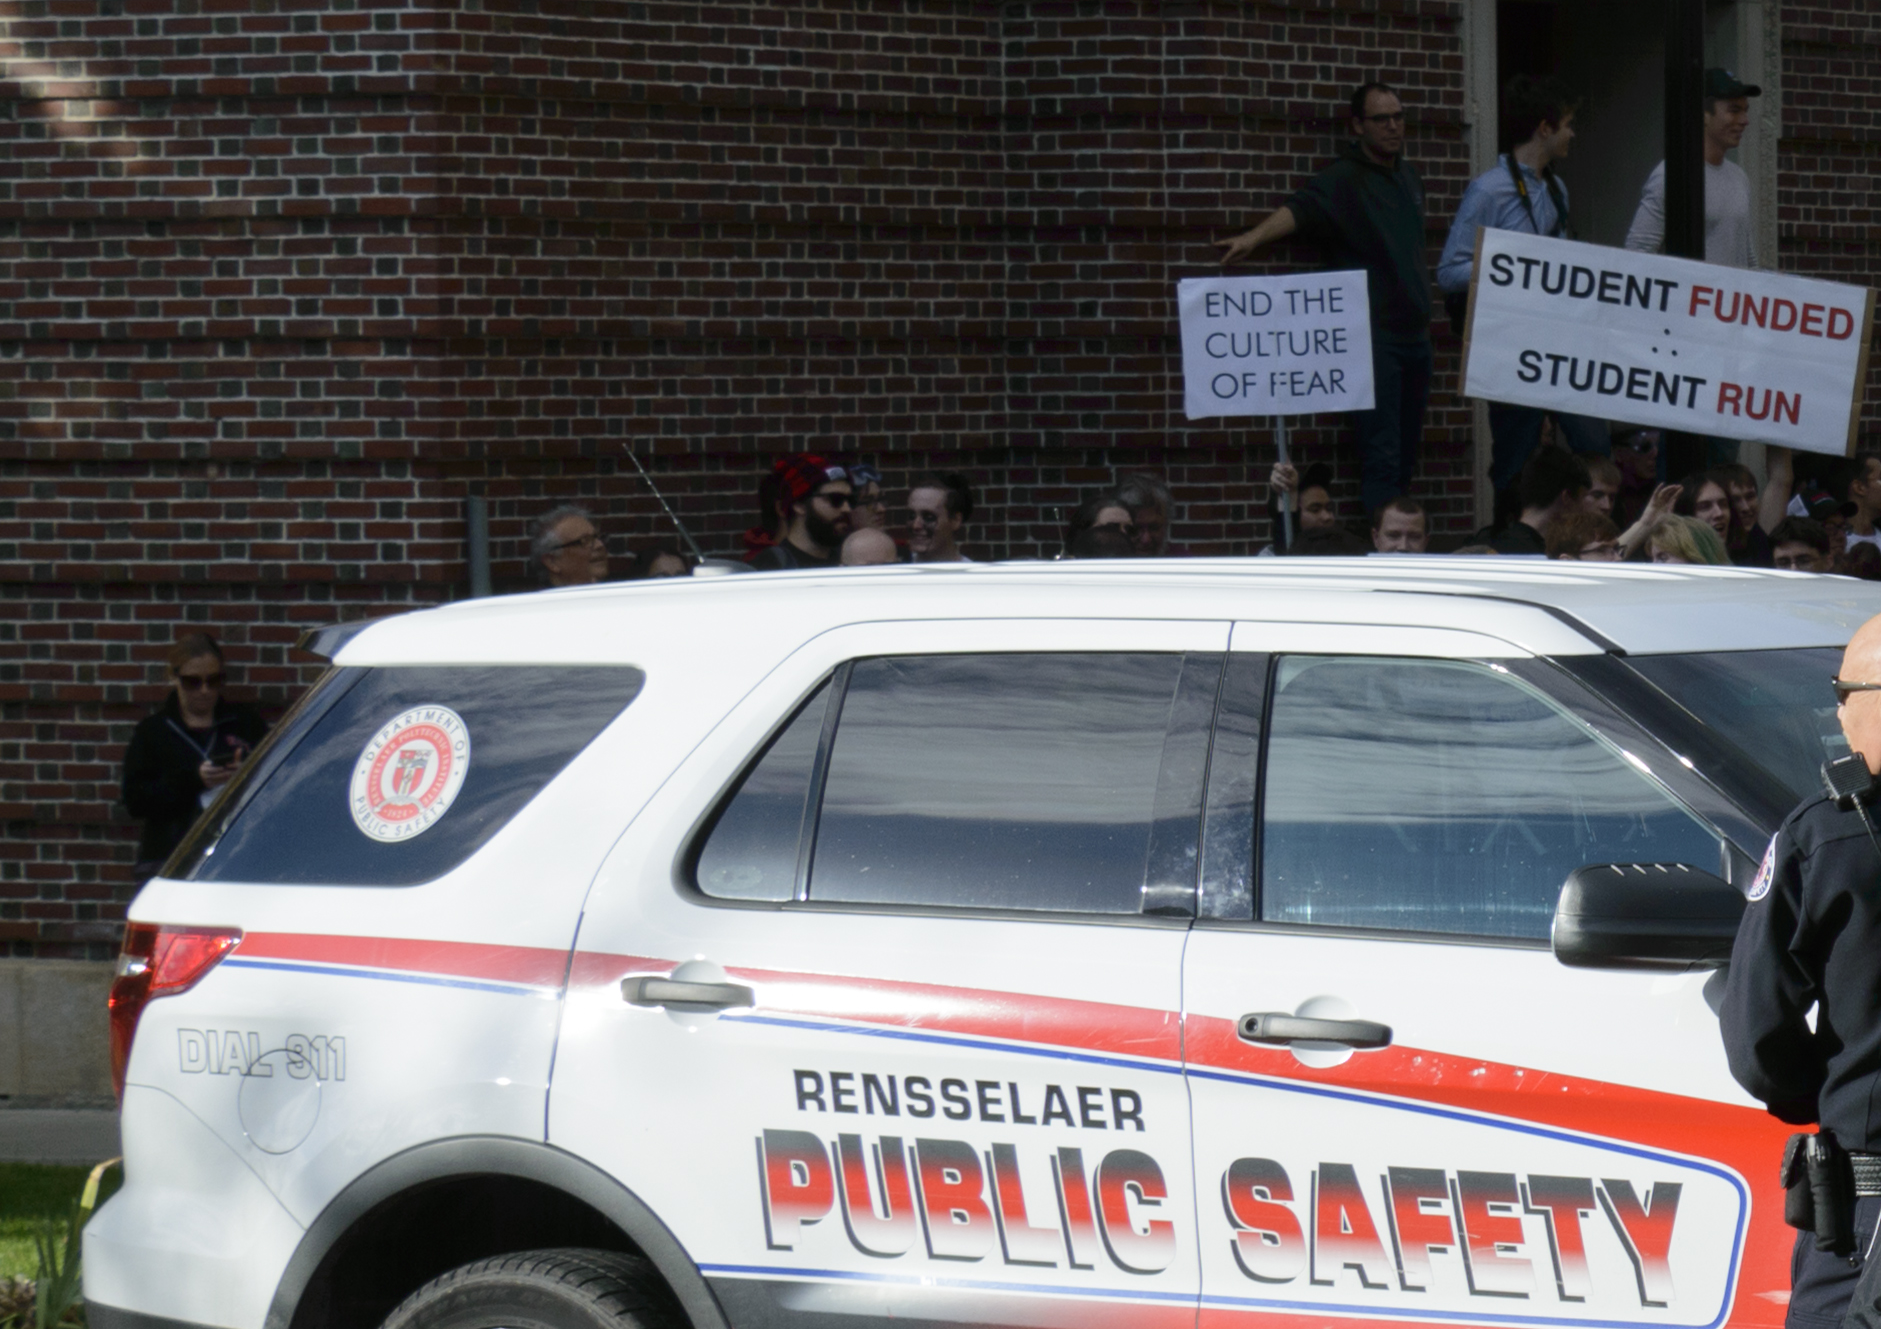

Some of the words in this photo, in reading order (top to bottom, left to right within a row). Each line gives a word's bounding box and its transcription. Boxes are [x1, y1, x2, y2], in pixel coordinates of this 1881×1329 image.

[1205, 291, 1272, 318] END
[1283, 287, 1344, 315] THE
[1488, 253, 1679, 312] STUDENT
[1689, 285, 1855, 341] FUNDED
[1205, 328, 1348, 359] CULTURE
[1211, 372, 1257, 399] OF
[1269, 369, 1347, 397] FEAR
[1517, 349, 1707, 409] STUDENT
[1716, 382, 1802, 425] RUN
[365, 711, 460, 761] DEPARTMENT
[454, 740, 465, 761] OF
[356, 796, 389, 836] PUBLIC
[394, 797, 445, 837] SAFETY
[177, 1028, 273, 1078] DIAL
[285, 1033, 346, 1082] 911
[792, 1066, 1147, 1133] RENSSELAER
[755, 1127, 1177, 1276] PUBLIC
[1222, 1156, 1684, 1309] SAFETY
